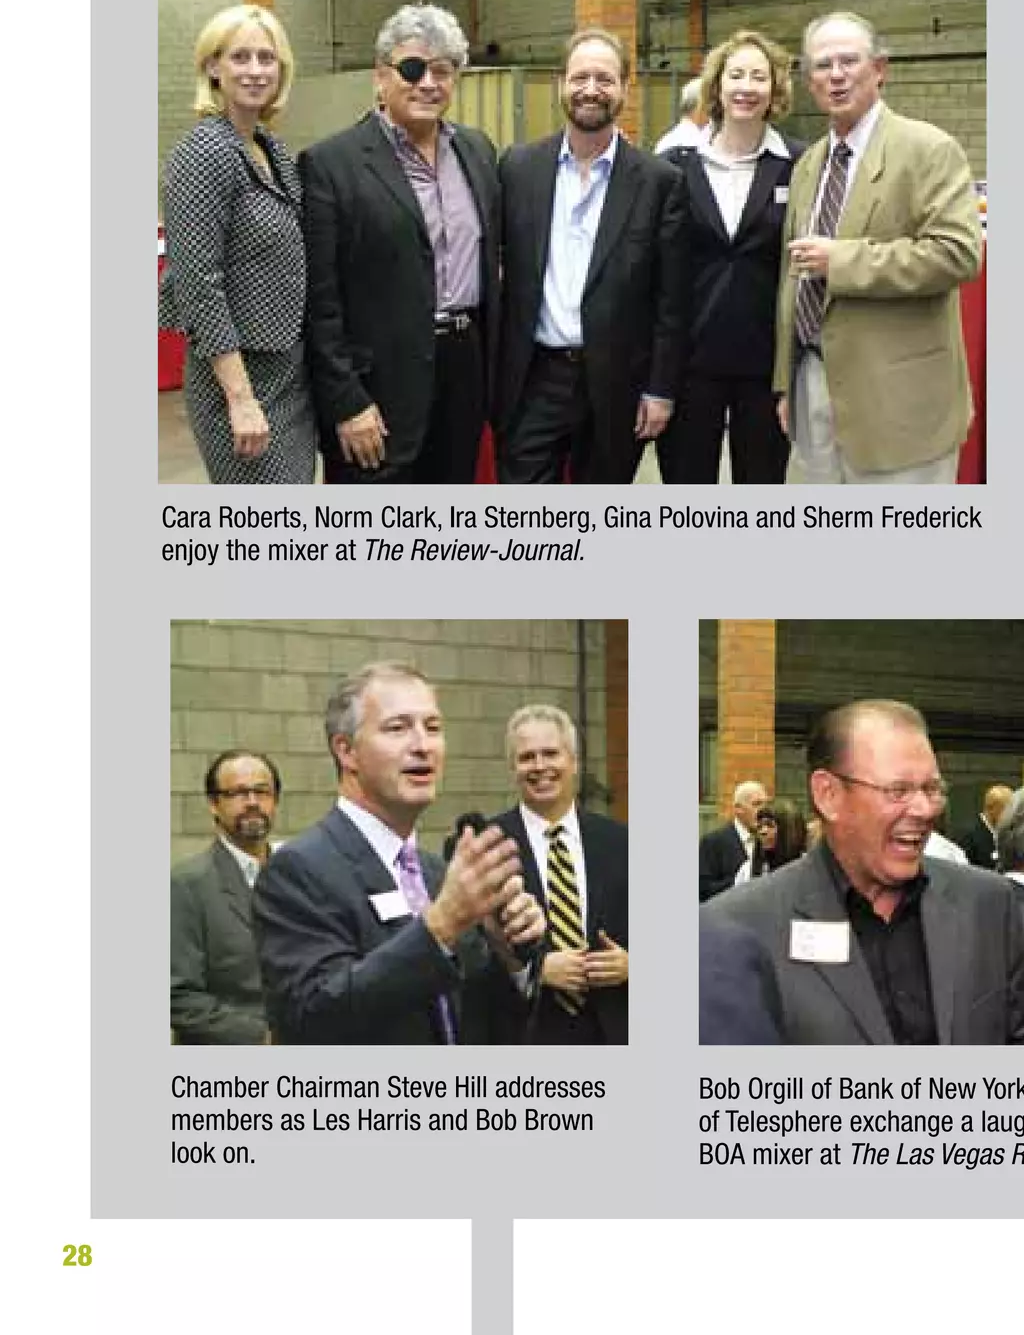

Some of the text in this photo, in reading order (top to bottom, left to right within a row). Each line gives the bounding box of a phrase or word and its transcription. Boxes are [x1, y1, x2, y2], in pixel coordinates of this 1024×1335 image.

[163, 506, 982, 533] Cara Roberts, Norm Clark, Ira Sternberg, Gina Polovina and Sherm Frederick
[172, 1076, 605, 1098] Chamber Chairman Steve Hill addresses
[700, 1077, 740, 1099] Bob
[749, 1077, 802, 1104] Orgill
[812, 1077, 832, 1099] of
[840, 1077, 894, 1099] Bank
[901, 1077, 921, 1099] of
[930, 1077, 976, 1099] New
[172, 1141, 254, 1163] look on.
[700, 1143, 745, 1165] BOA
[754, 1143, 813, 1165] mixer
[820, 1144, 841, 1165] at
[852, 1143, 889, 1165] The
[896, 1143, 934, 1165] Las
[943, 1143, 1005, 1170] Vegas
[63, 1244, 92, 1266] 28
